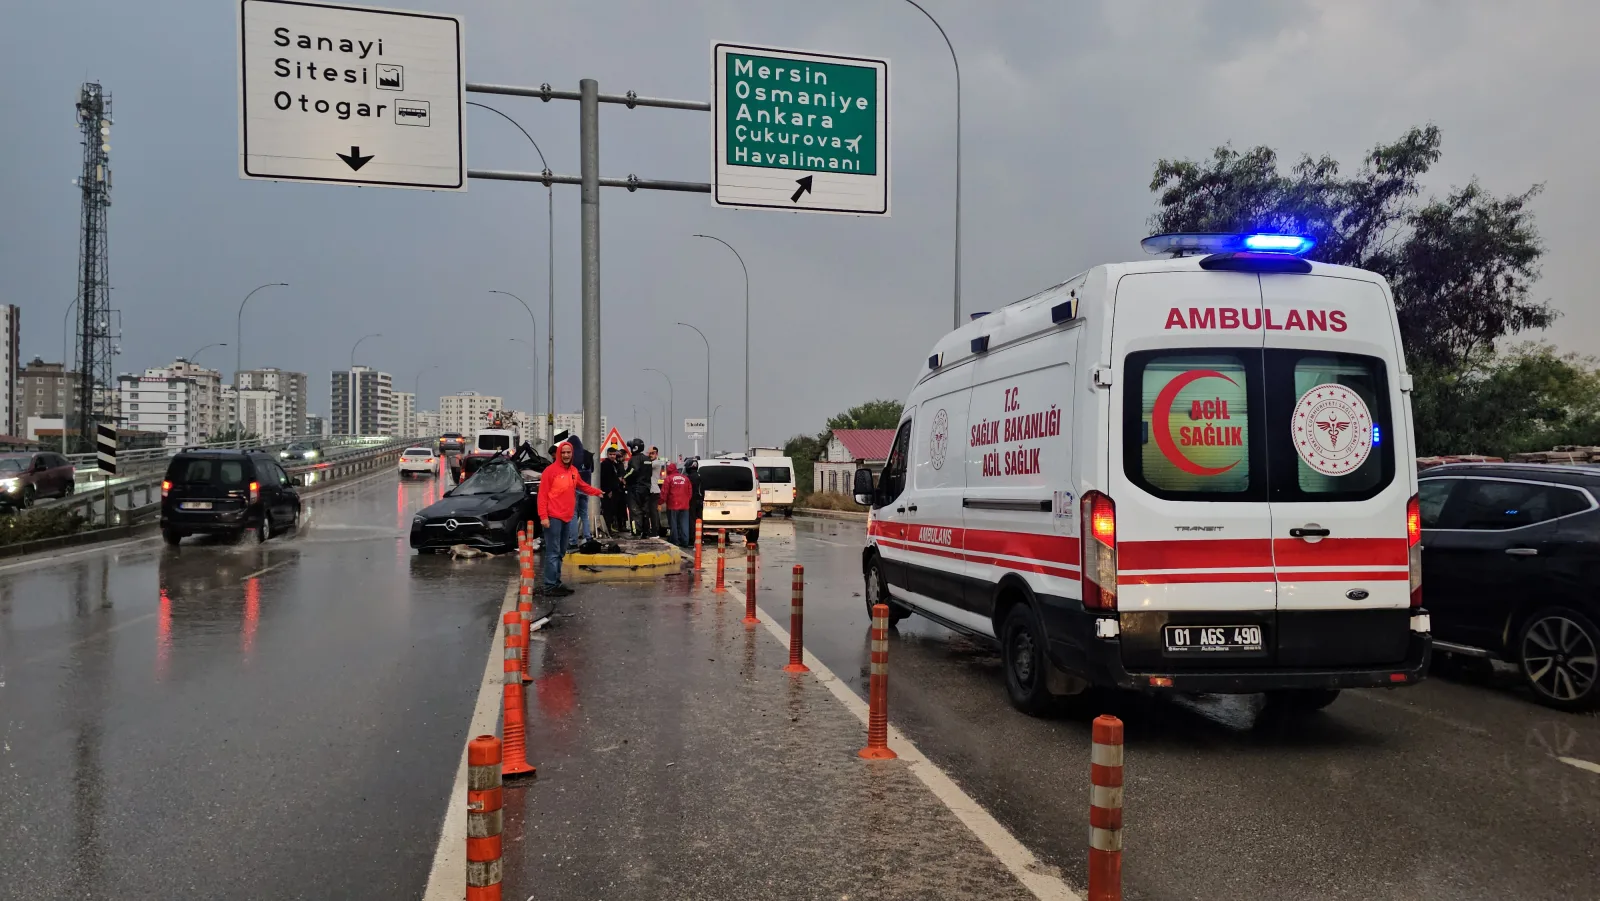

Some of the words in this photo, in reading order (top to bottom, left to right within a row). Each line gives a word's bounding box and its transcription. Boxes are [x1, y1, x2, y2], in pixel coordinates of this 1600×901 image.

[273, 26, 383, 59] Sanayi
[273, 57, 368, 84] Sitesi
[734, 58, 827, 85] Mersin
[273, 91, 387, 120] Otogar
[735, 80, 869, 113] Osmaniye
[735, 103, 833, 129] Ankara
[735, 124, 842, 149] Çukurova
[735, 146, 860, 171] Havalimanı
[1164, 307, 1348, 333] AMBULANS
[1004, 386, 1020, 413] T.C.
[1190, 396, 1231, 420] ACİL
[970, 418, 1001, 447] SAĞLIK
[1003, 404, 1061, 443] BAKANLIĞI
[1179, 422, 1243, 447] SAĞLIK
[982, 448, 1002, 477] ACİL
[1004, 444, 1041, 476] SAĞLIK
[918, 526, 952, 545] AMBULANS
[1174, 628, 1191, 646] 01
[1200, 628, 1225, 645] AGS
[1233, 627, 1259, 645] 490
